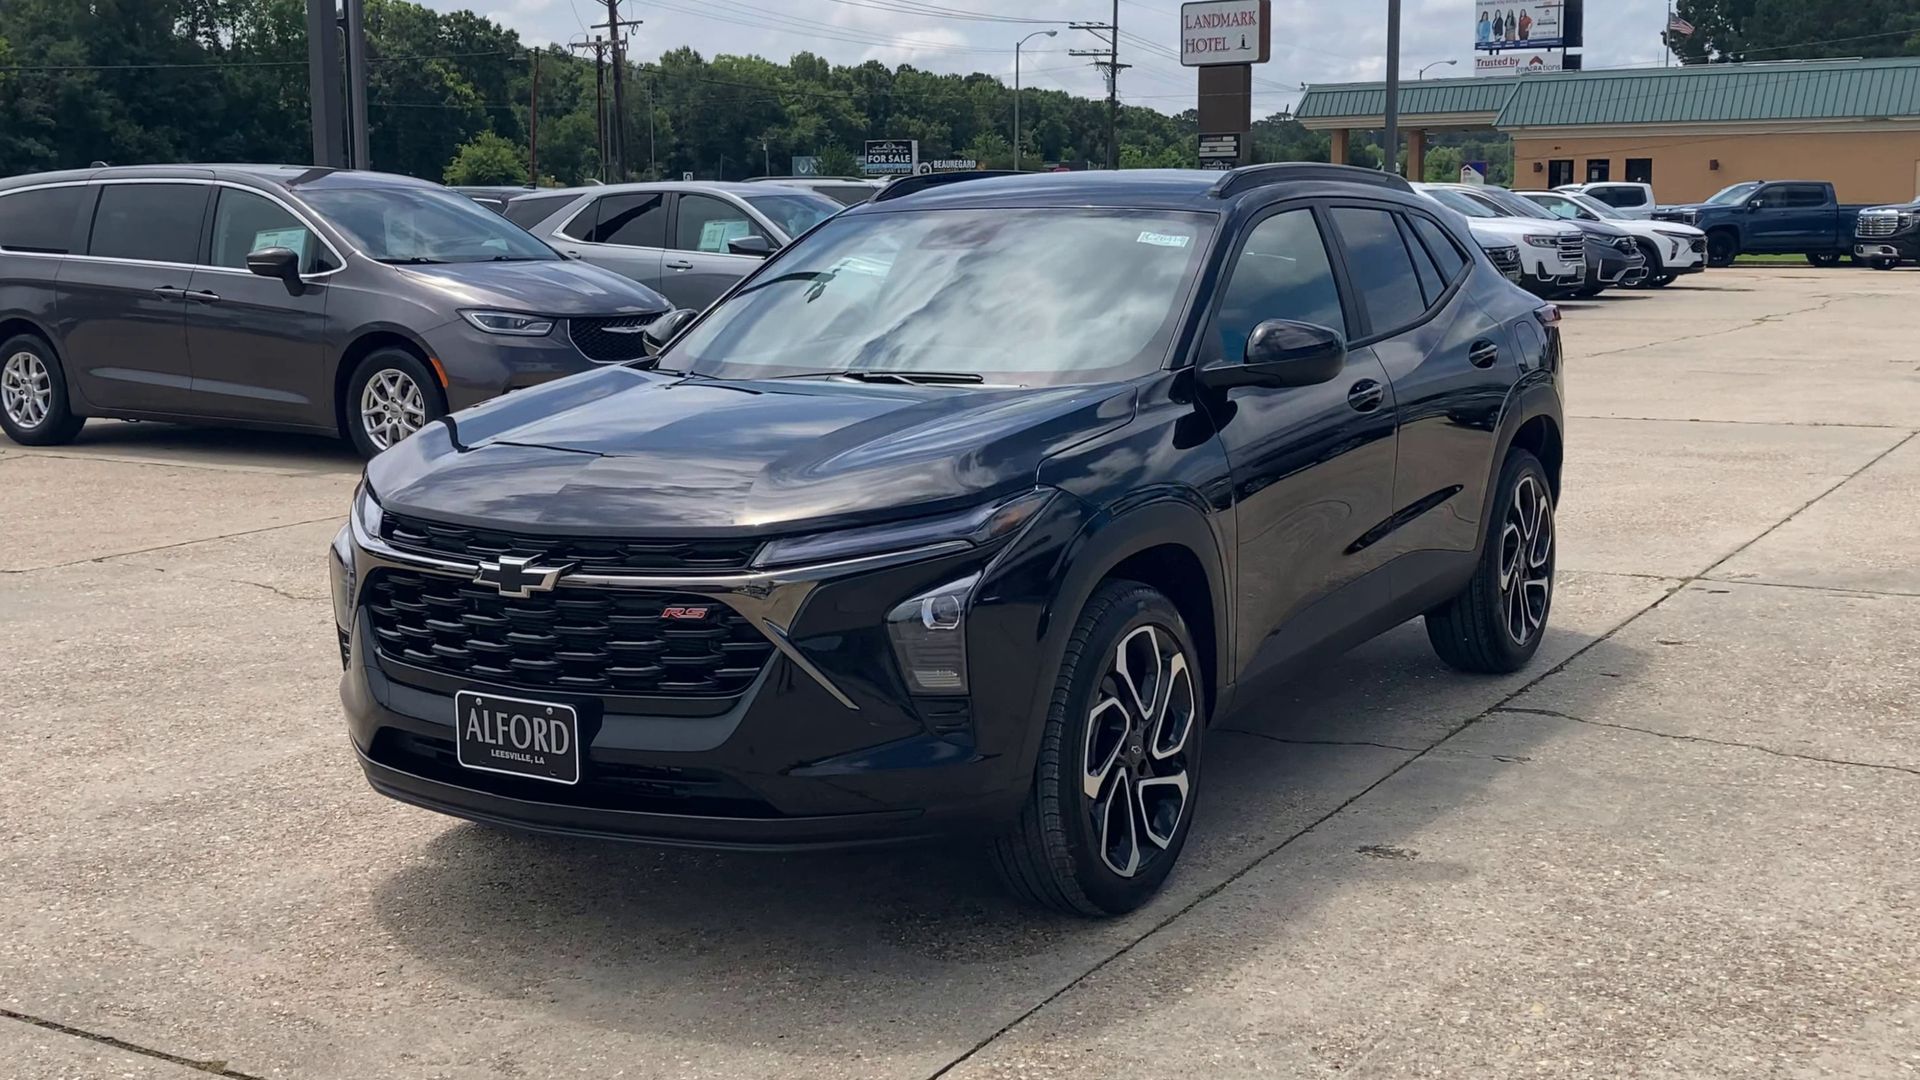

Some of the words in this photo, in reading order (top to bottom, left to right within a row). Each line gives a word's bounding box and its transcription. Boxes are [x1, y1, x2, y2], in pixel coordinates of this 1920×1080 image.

[1184, 11, 1257, 30] LANDMARK
[1184, 37, 1231, 54] HOTEL
[1476, 57, 1508, 67] Trusted
[1509, 56, 1520, 67] by
[868, 155, 887, 163] FOR
[888, 154, 911, 163] SALE
[933, 159, 976, 169] BEAUREGARD
[661, 607, 709, 619] RS
[465, 707, 570, 755] ALFORD
[491, 749, 534, 764] LEESVILLE,
[534, 755, 545, 765] LA
